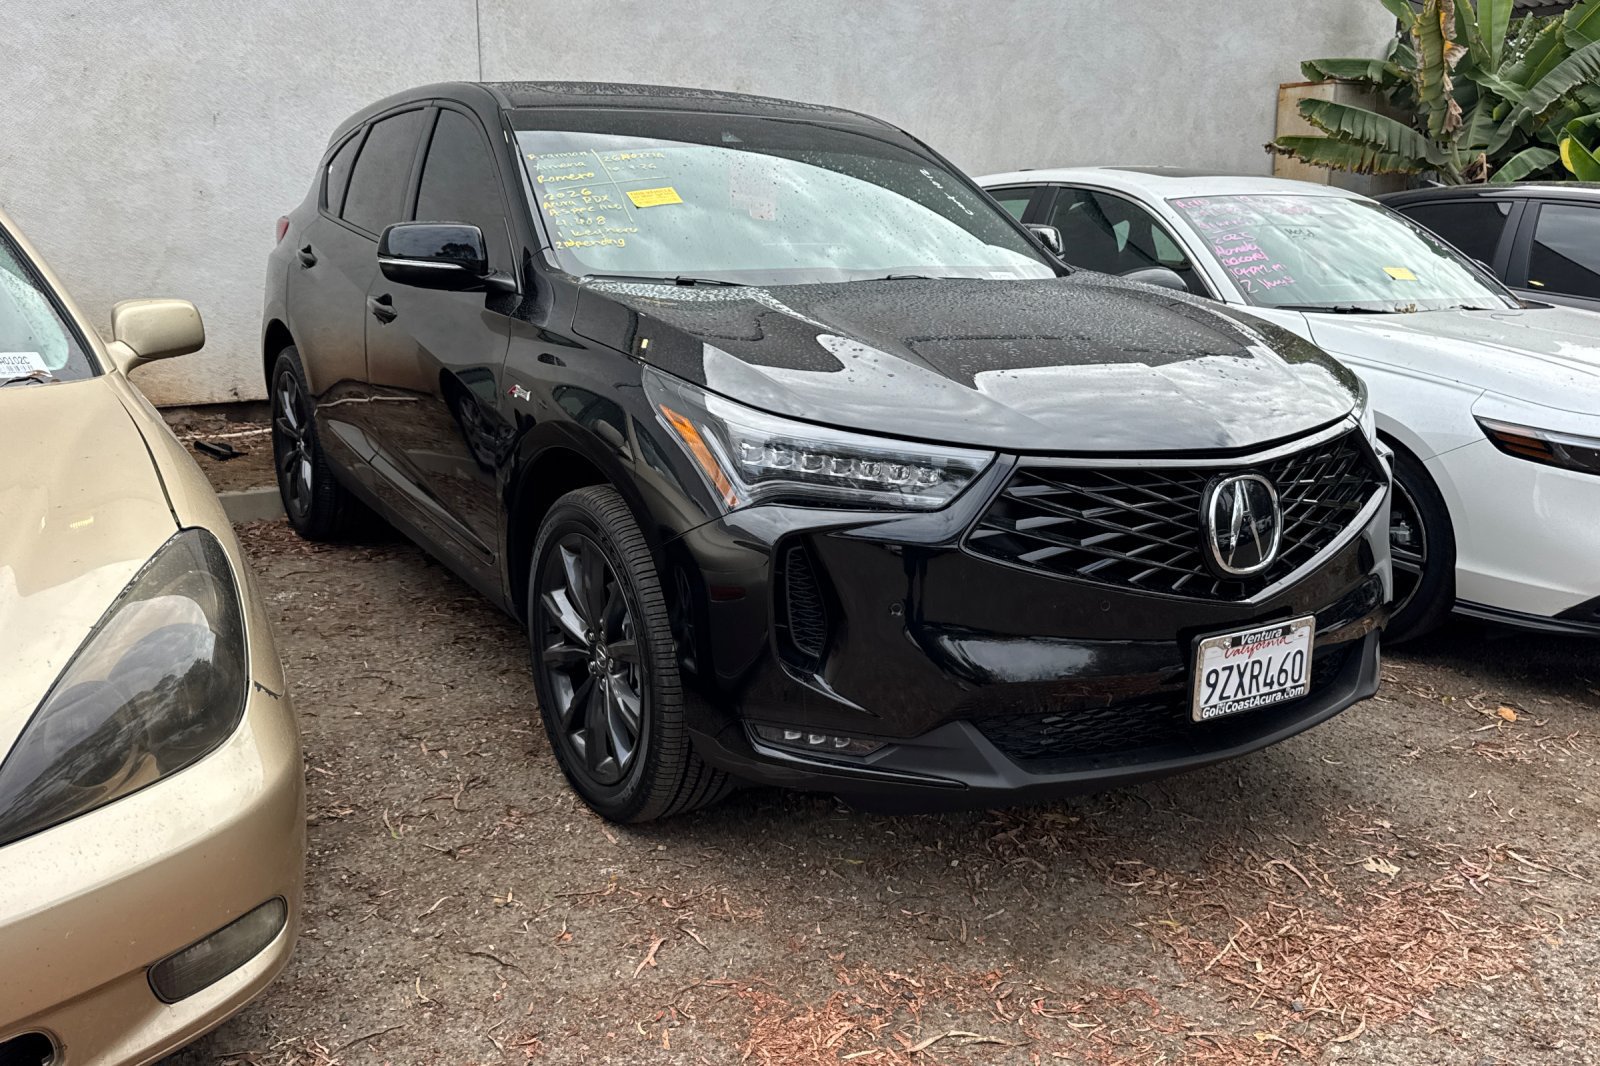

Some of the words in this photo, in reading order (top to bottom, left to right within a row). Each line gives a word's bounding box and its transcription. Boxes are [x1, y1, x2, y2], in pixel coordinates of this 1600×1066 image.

[536, 172, 595, 184] Romero
[543, 187, 593, 201] 2026
[582, 194, 609, 204] RDX
[1214, 241, 1262, 256] Honda
[1239, 279, 1259, 294] 2
[1240, 629, 1282, 645] Ventura
[1224, 636, 1293, 659] California
[1203, 649, 1304, 705] 9ZXR460
